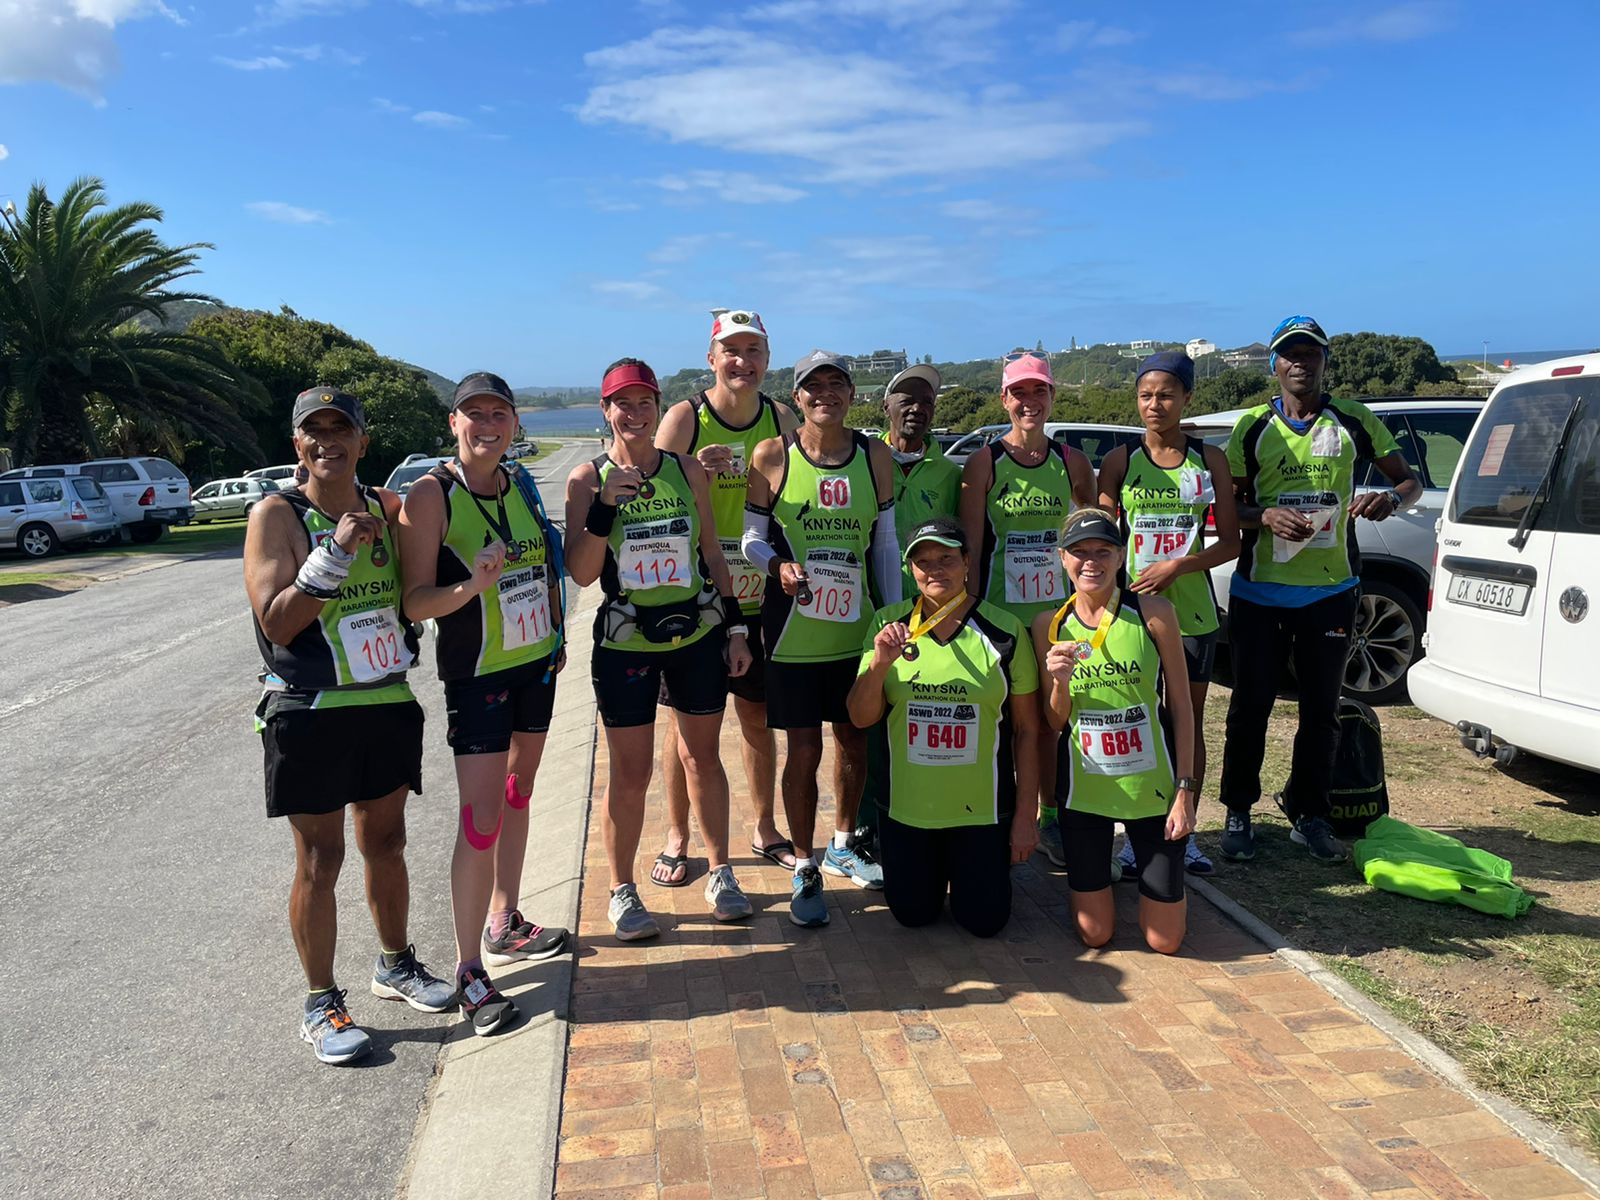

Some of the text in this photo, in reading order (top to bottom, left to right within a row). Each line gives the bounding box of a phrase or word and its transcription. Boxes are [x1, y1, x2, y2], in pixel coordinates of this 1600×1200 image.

[1281, 464, 1330, 475] KNYSNA
[820, 479, 848, 507] 60
[1133, 487, 1180, 500] KNYS
[1302, 495, 1319, 504] 2022
[617, 496, 687, 516] KNYSNA
[1002, 495, 1063, 509] KNYSNA
[622, 510, 689, 525] MARATHON CLUB
[1005, 510, 1043, 518] MARATHON
[651, 525, 668, 536] 2022
[803, 518, 861, 531] KNYSNA
[519, 536, 545, 553] SNA
[721, 543, 738, 551] SWD
[1134, 533, 1144, 554] P
[830, 551, 846, 560] 2022
[635, 558, 680, 584] 112
[814, 567, 850, 579] OUTENIQUA
[1018, 570, 1055, 599] 113
[1457, 580, 1514, 607] CX 60518
[341, 599, 382, 612] MARATHO
[814, 586, 852, 616] 103
[518, 602, 548, 641] 111
[362, 631, 402, 671] 102
[1071, 660, 1142, 680] KNYSNA
[912, 683, 968, 695] KNYSNA
[1073, 677, 1141, 691] MARATHON CLUB
[908, 707, 953, 718] ASWD 2022
[1080, 713, 1123, 726] ASWD 2022
[908, 722, 967, 749] P 640
[1081, 728, 1143, 756] P 684
